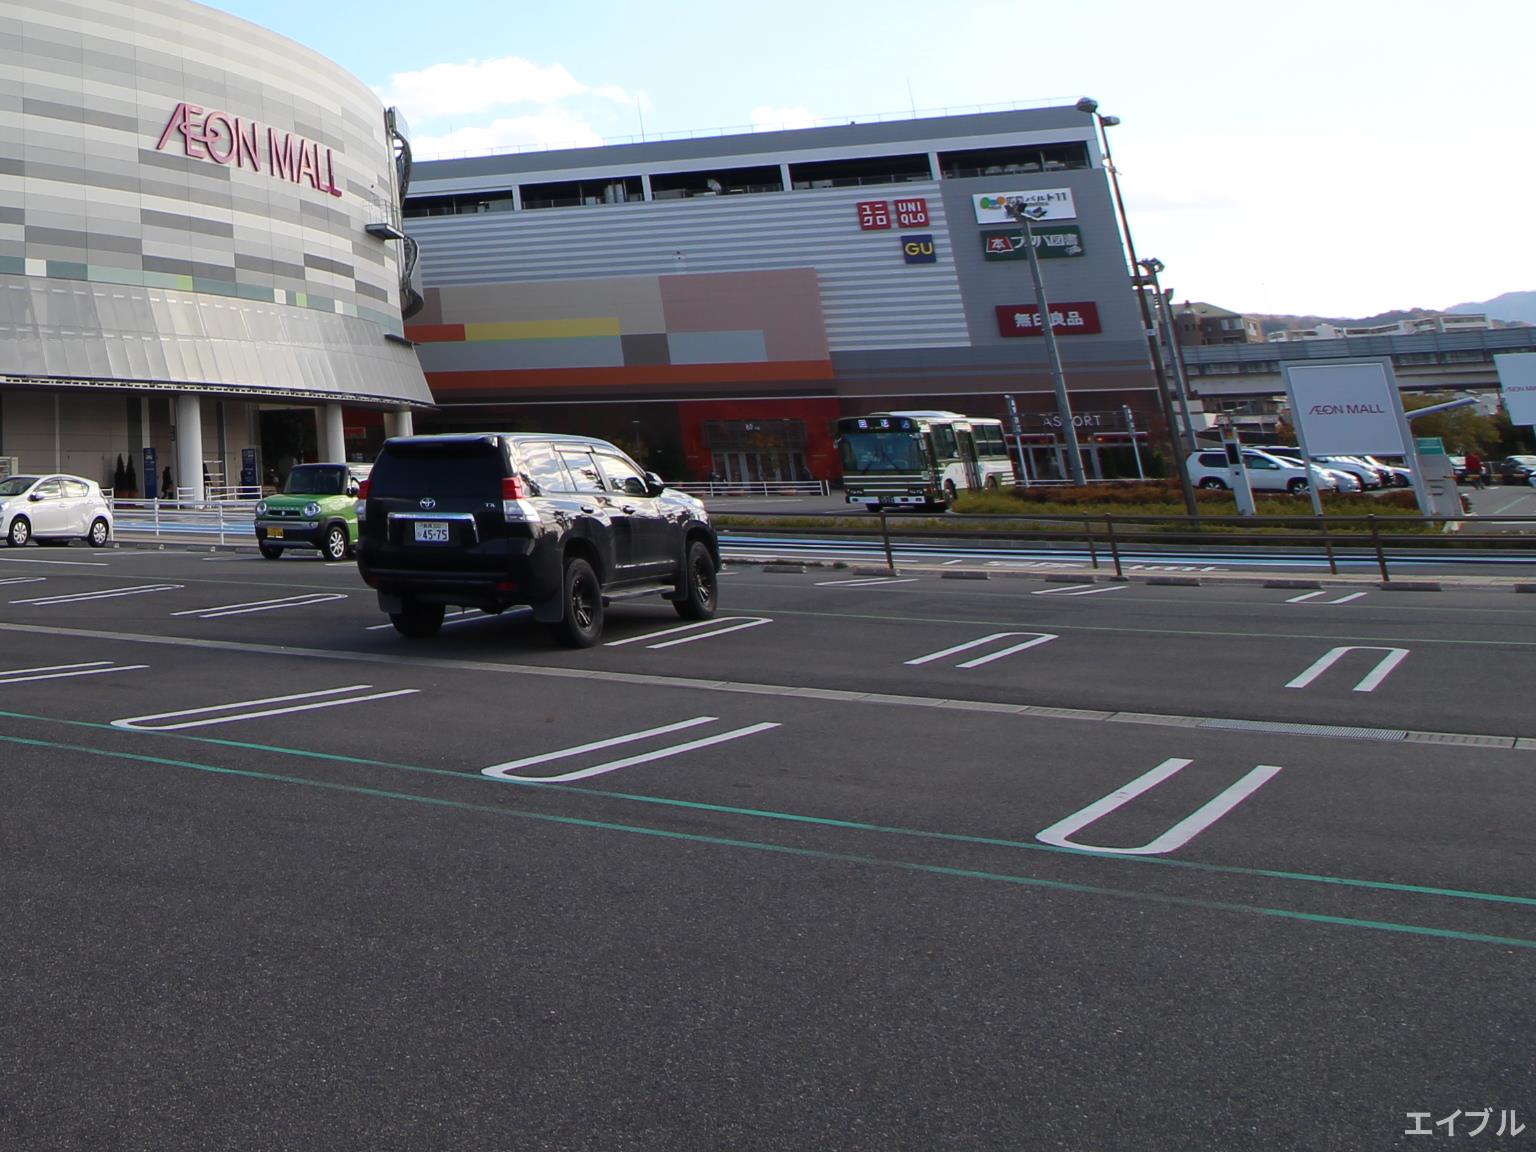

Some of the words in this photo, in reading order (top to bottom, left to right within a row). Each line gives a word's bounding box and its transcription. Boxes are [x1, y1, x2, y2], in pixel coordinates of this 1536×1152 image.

[267, 127, 342, 197] MALL
[898, 202, 922, 212] UNI
[900, 213, 926, 225] QLO
[905, 242, 933, 255] GU
[1346, 404, 1385, 414] MALL
[1043, 415, 1101, 427] ASORT
[423, 529, 448, 540] 45-75
